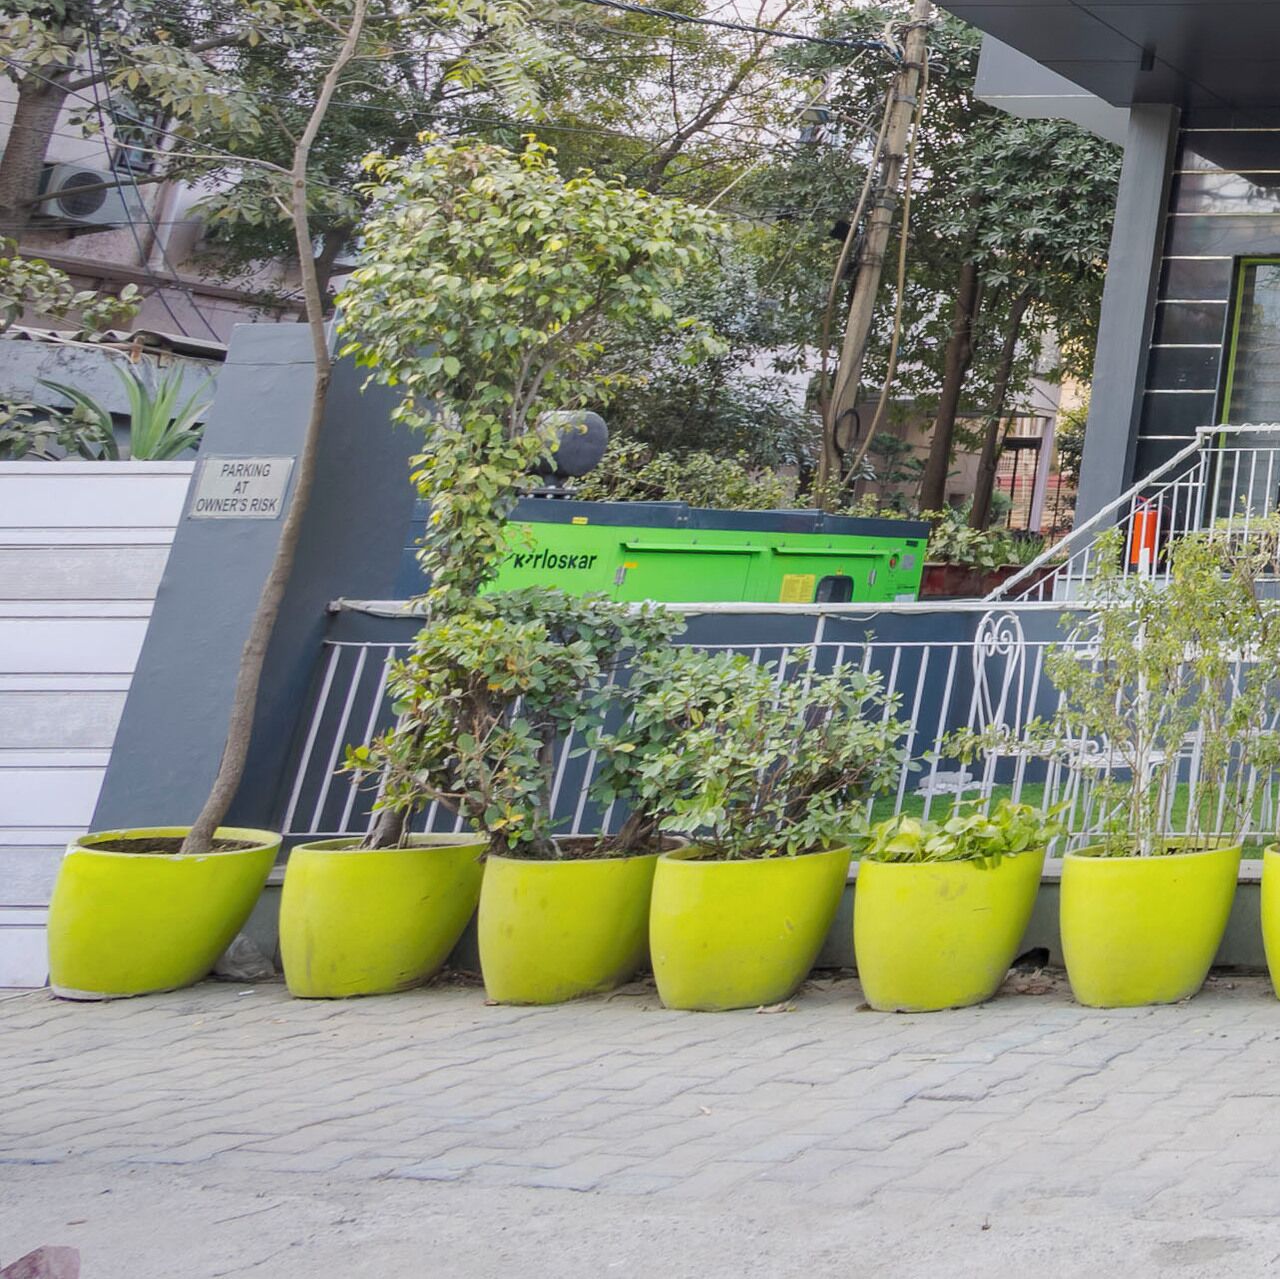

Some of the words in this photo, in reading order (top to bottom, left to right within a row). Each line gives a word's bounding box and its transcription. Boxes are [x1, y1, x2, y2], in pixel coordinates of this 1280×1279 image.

[220, 463, 271, 477] PARKING
[233, 481, 250, 494] AT
[196, 498, 247, 512] OWNER'S
[249, 498, 278, 512] RISK
